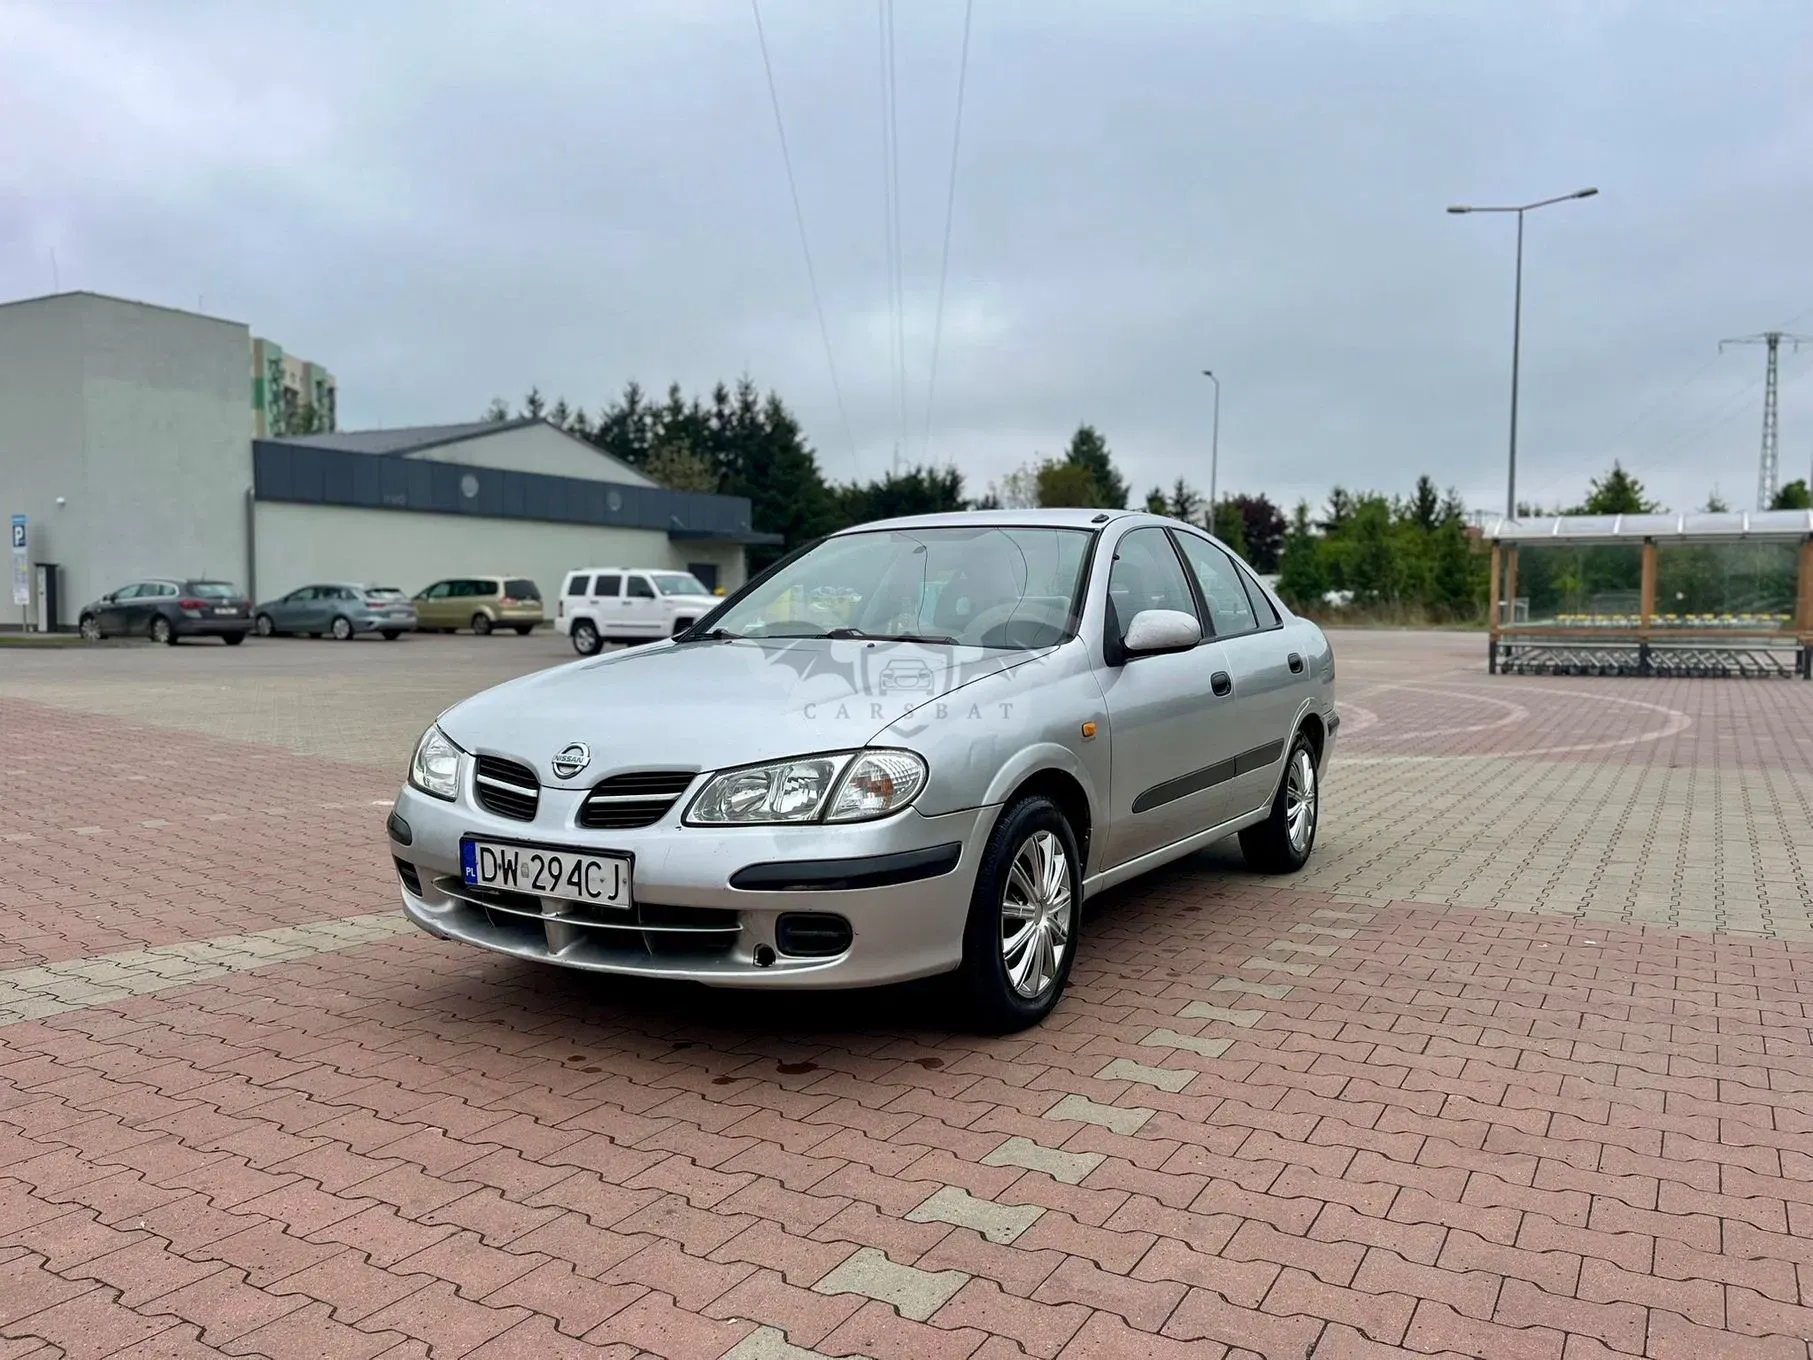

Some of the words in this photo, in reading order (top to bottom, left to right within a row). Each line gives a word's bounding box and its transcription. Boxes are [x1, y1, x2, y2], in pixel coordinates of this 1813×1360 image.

[14, 526, 24, 546] P
[553, 754, 584, 764] NISSAN
[466, 867, 476, 877] PL
[480, 847, 519, 887] DW
[530, 853, 619, 900] 294CJ
